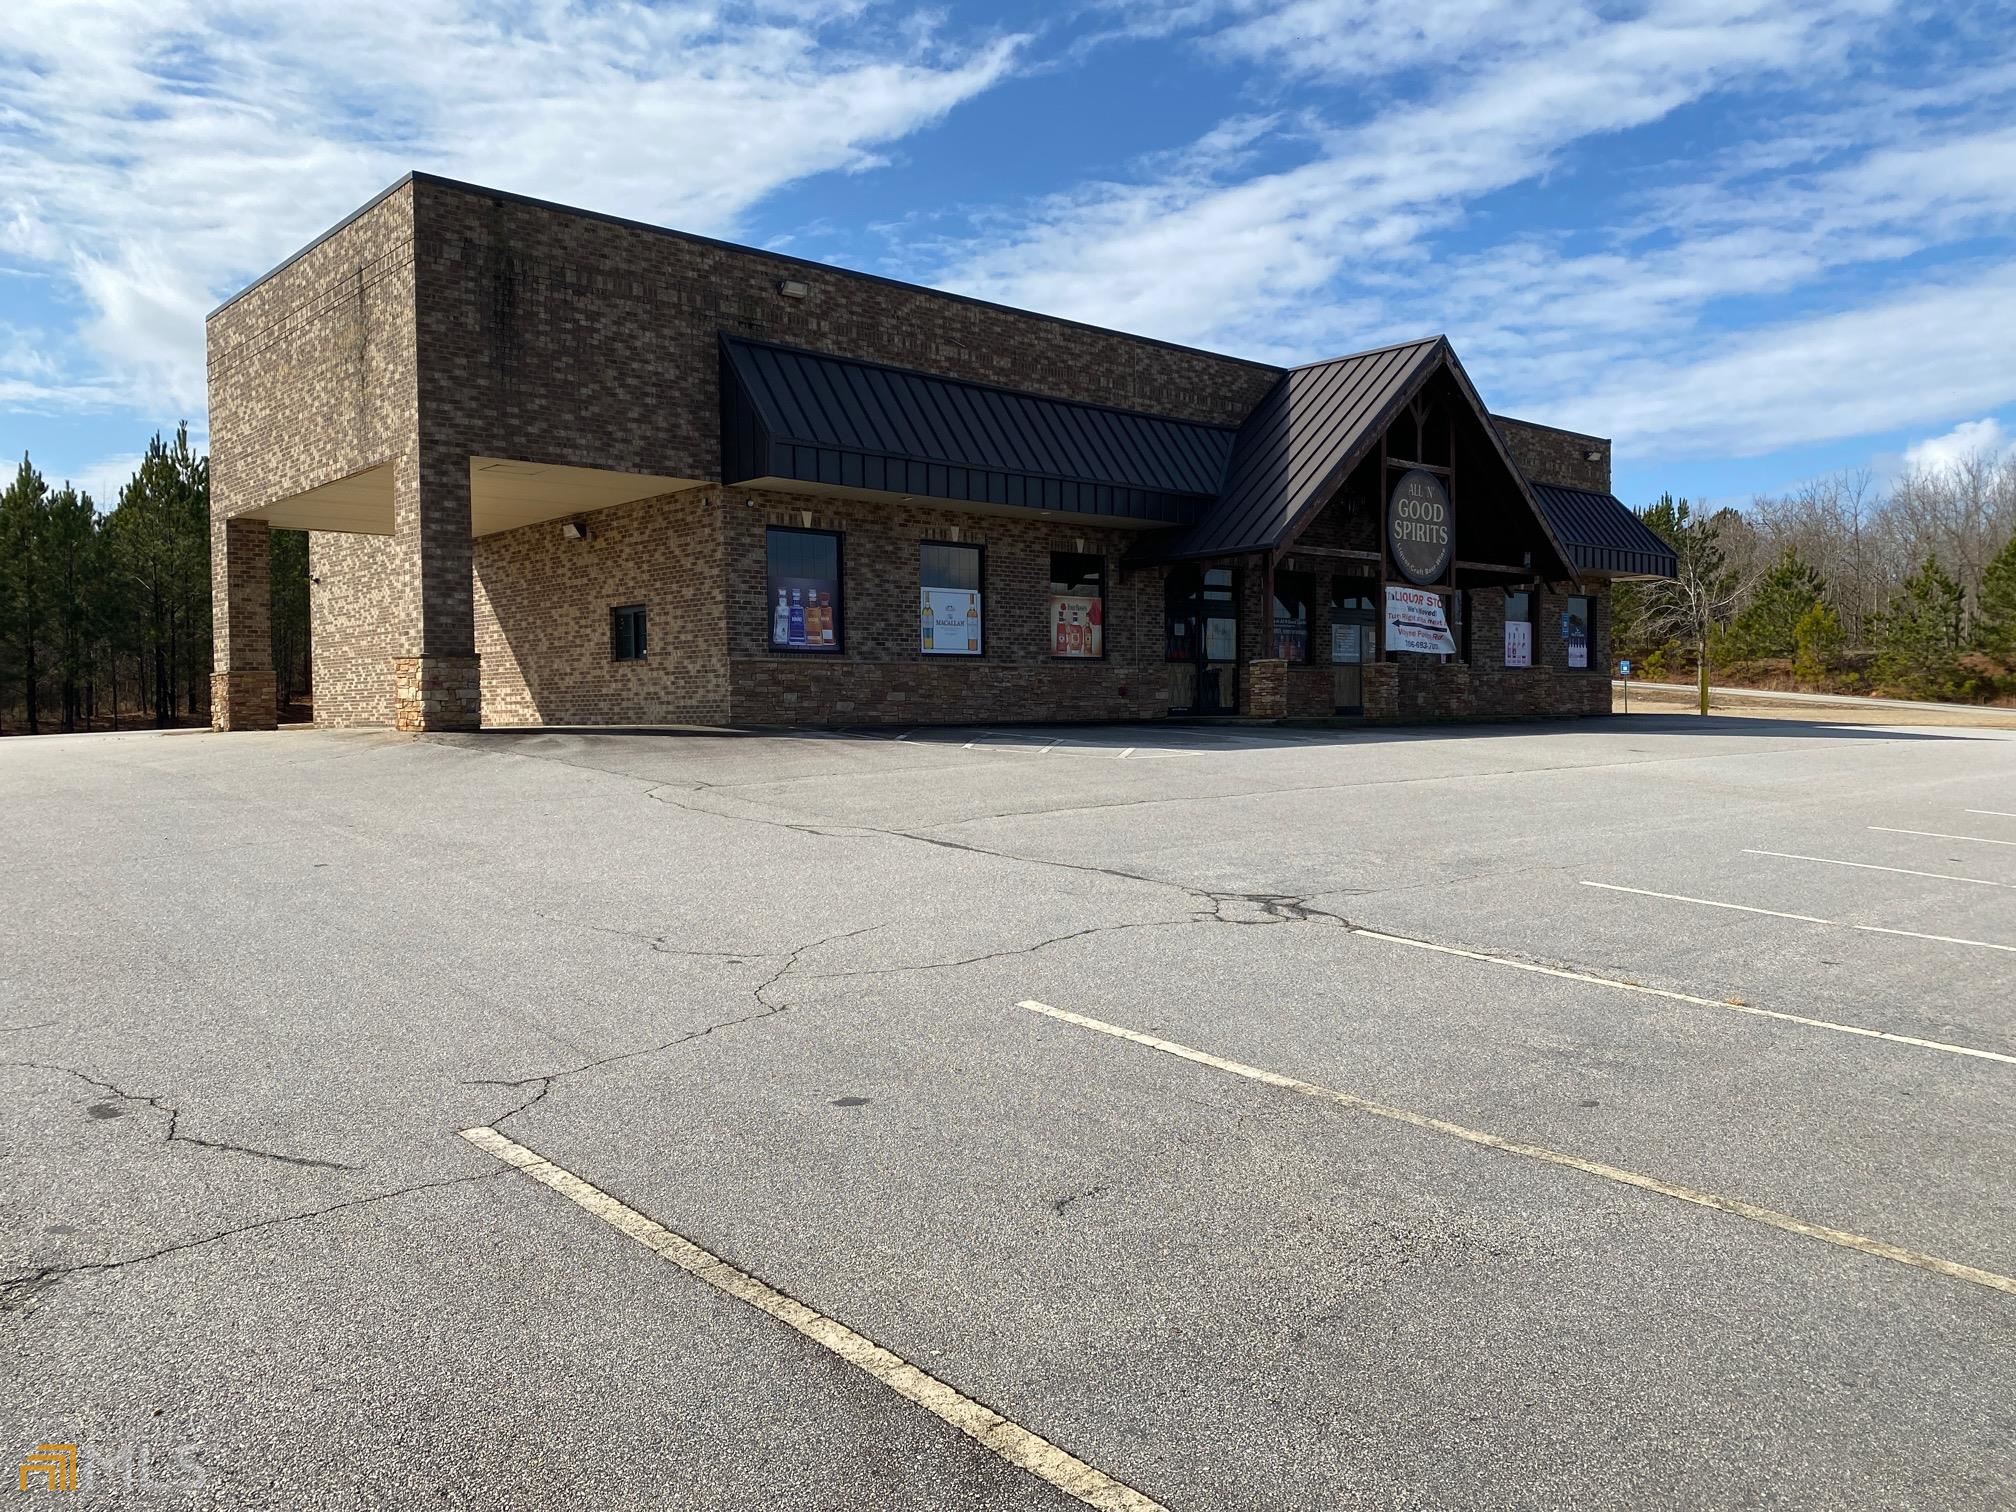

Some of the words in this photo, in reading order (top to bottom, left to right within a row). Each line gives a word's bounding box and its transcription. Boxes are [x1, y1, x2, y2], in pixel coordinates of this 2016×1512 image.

[1408, 482, 1423, 498] ALL
[1398, 498, 1444, 522] GOOD
[1394, 519, 1449, 545] SPIRITS
[1410, 564, 1424, 576] Craft
[1395, 591, 1424, 606] LIQUOR
